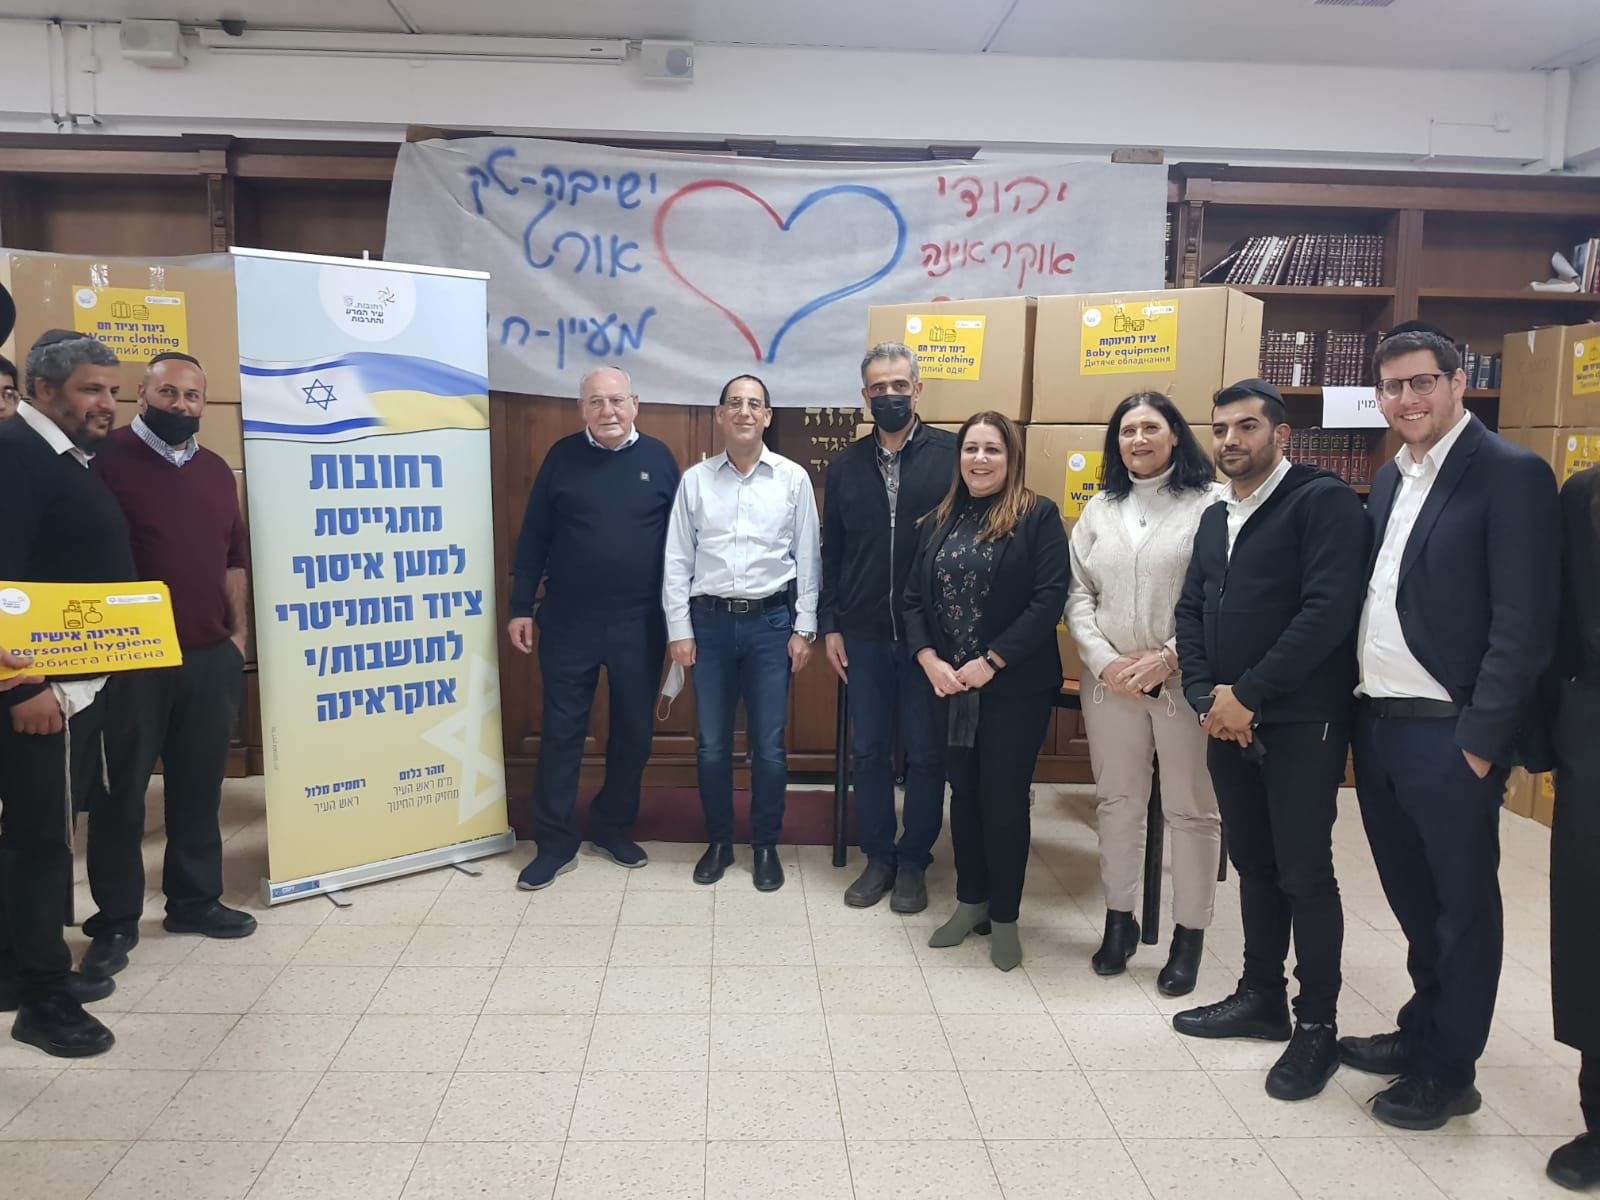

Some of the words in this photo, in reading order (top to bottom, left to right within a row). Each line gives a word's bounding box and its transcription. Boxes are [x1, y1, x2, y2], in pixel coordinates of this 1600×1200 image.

[938, 176, 1067, 217] יהודי
[523, 200, 642, 277] אורט
[920, 240, 1075, 289] אוקראינה
[129, 333, 180, 347] clothing
[1138, 335, 1157, 343] ציוד
[1085, 348, 1112, 358] Baby
[1115, 345, 1170, 358] equipment
[915, 354, 935, 362] arm
[938, 354, 975, 366] clothing
[1084, 359, 1115, 368] Дитяче
[1118, 356, 1171, 365] обладнання
[309, 454, 443, 490] רחובות
[314, 505, 443, 537] מתגייסת
[292, 552, 384, 589] איסוף
[393, 544, 466, 583] למען
[422, 590, 483, 619] ציוד
[275, 595, 414, 631] הומניטרי
[31, 631, 81, 643] אישית
[86, 626, 140, 641] היגיינה
[10, 643, 87, 656] personal
[94, 638, 161, 651] hygiene
[304, 630, 463, 677] לתושבות/י
[35, 656, 100, 668] обиста
[106, 650, 164, 663] гігієна
[316, 677, 457, 722] אוקראינה
[399, 768, 422, 781] בלום
[424, 764, 445, 776] זוהר
[304, 785, 330, 798] מלול
[332, 778, 366, 793] רחמים
[393, 783, 413, 796] העיר
[416, 780, 435, 791] ראש
[339, 795, 360, 808] ראש
[416, 794, 432, 808] תיק
[434, 789, 460, 803] מחזיק
[314, 801, 336, 813] העיר
[387, 797, 414, 813] החינוך
